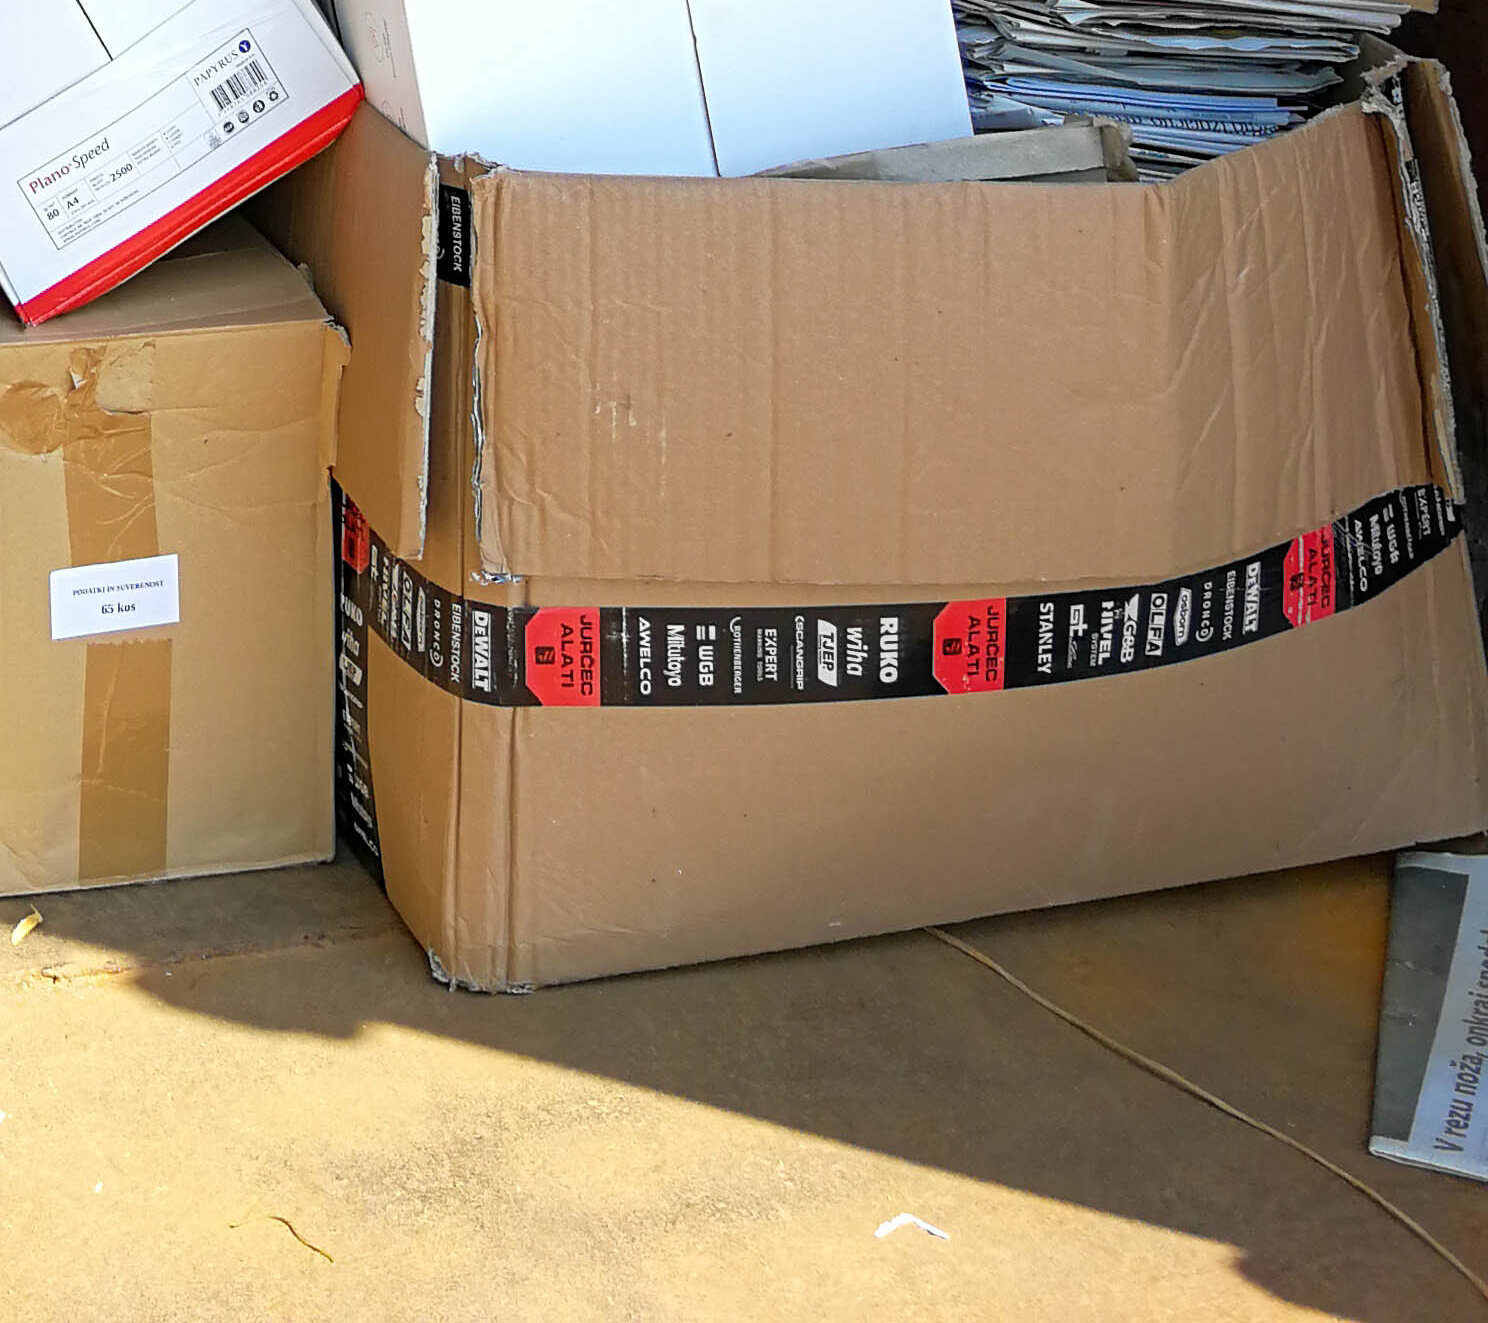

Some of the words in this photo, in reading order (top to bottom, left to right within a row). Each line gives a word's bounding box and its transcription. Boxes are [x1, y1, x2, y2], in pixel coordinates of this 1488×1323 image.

[193, 49, 239, 86] PAPYRUS
[29, 163, 70, 194] Plano
[71, 137, 111, 170] Speed
[111, 163, 134, 183] 2500
[46, 208, 60, 221] 80
[451, 195, 462, 272] EIBENSTOCK
[101, 604, 114, 615] 65
[117, 602, 136, 613] kos
[401, 571, 413, 651] OLFA
[429, 599, 443, 667] DRONCO
[1145, 594, 1166, 655] OLFA
[1196, 582, 1213, 642] DRONCO
[1222, 570, 1236, 640] EIBENSTOCK
[450, 603, 461, 683] EIBENSTOCK
[561, 624, 574, 688] ALATI
[639, 616, 652, 695] AWELCO
[663, 624, 685, 686] Mitutoyo
[698, 646, 714, 686] WGB
[764, 628, 778, 681] EXPERT
[845, 627, 868, 676] wiha
[879, 617, 899, 683] RUKO
[967, 615, 981, 677] ALATI
[1037, 602, 1054, 674] STANLEY
[1433, 1138, 1465, 1154] V
[1444, 1095, 1470, 1143] rezu
